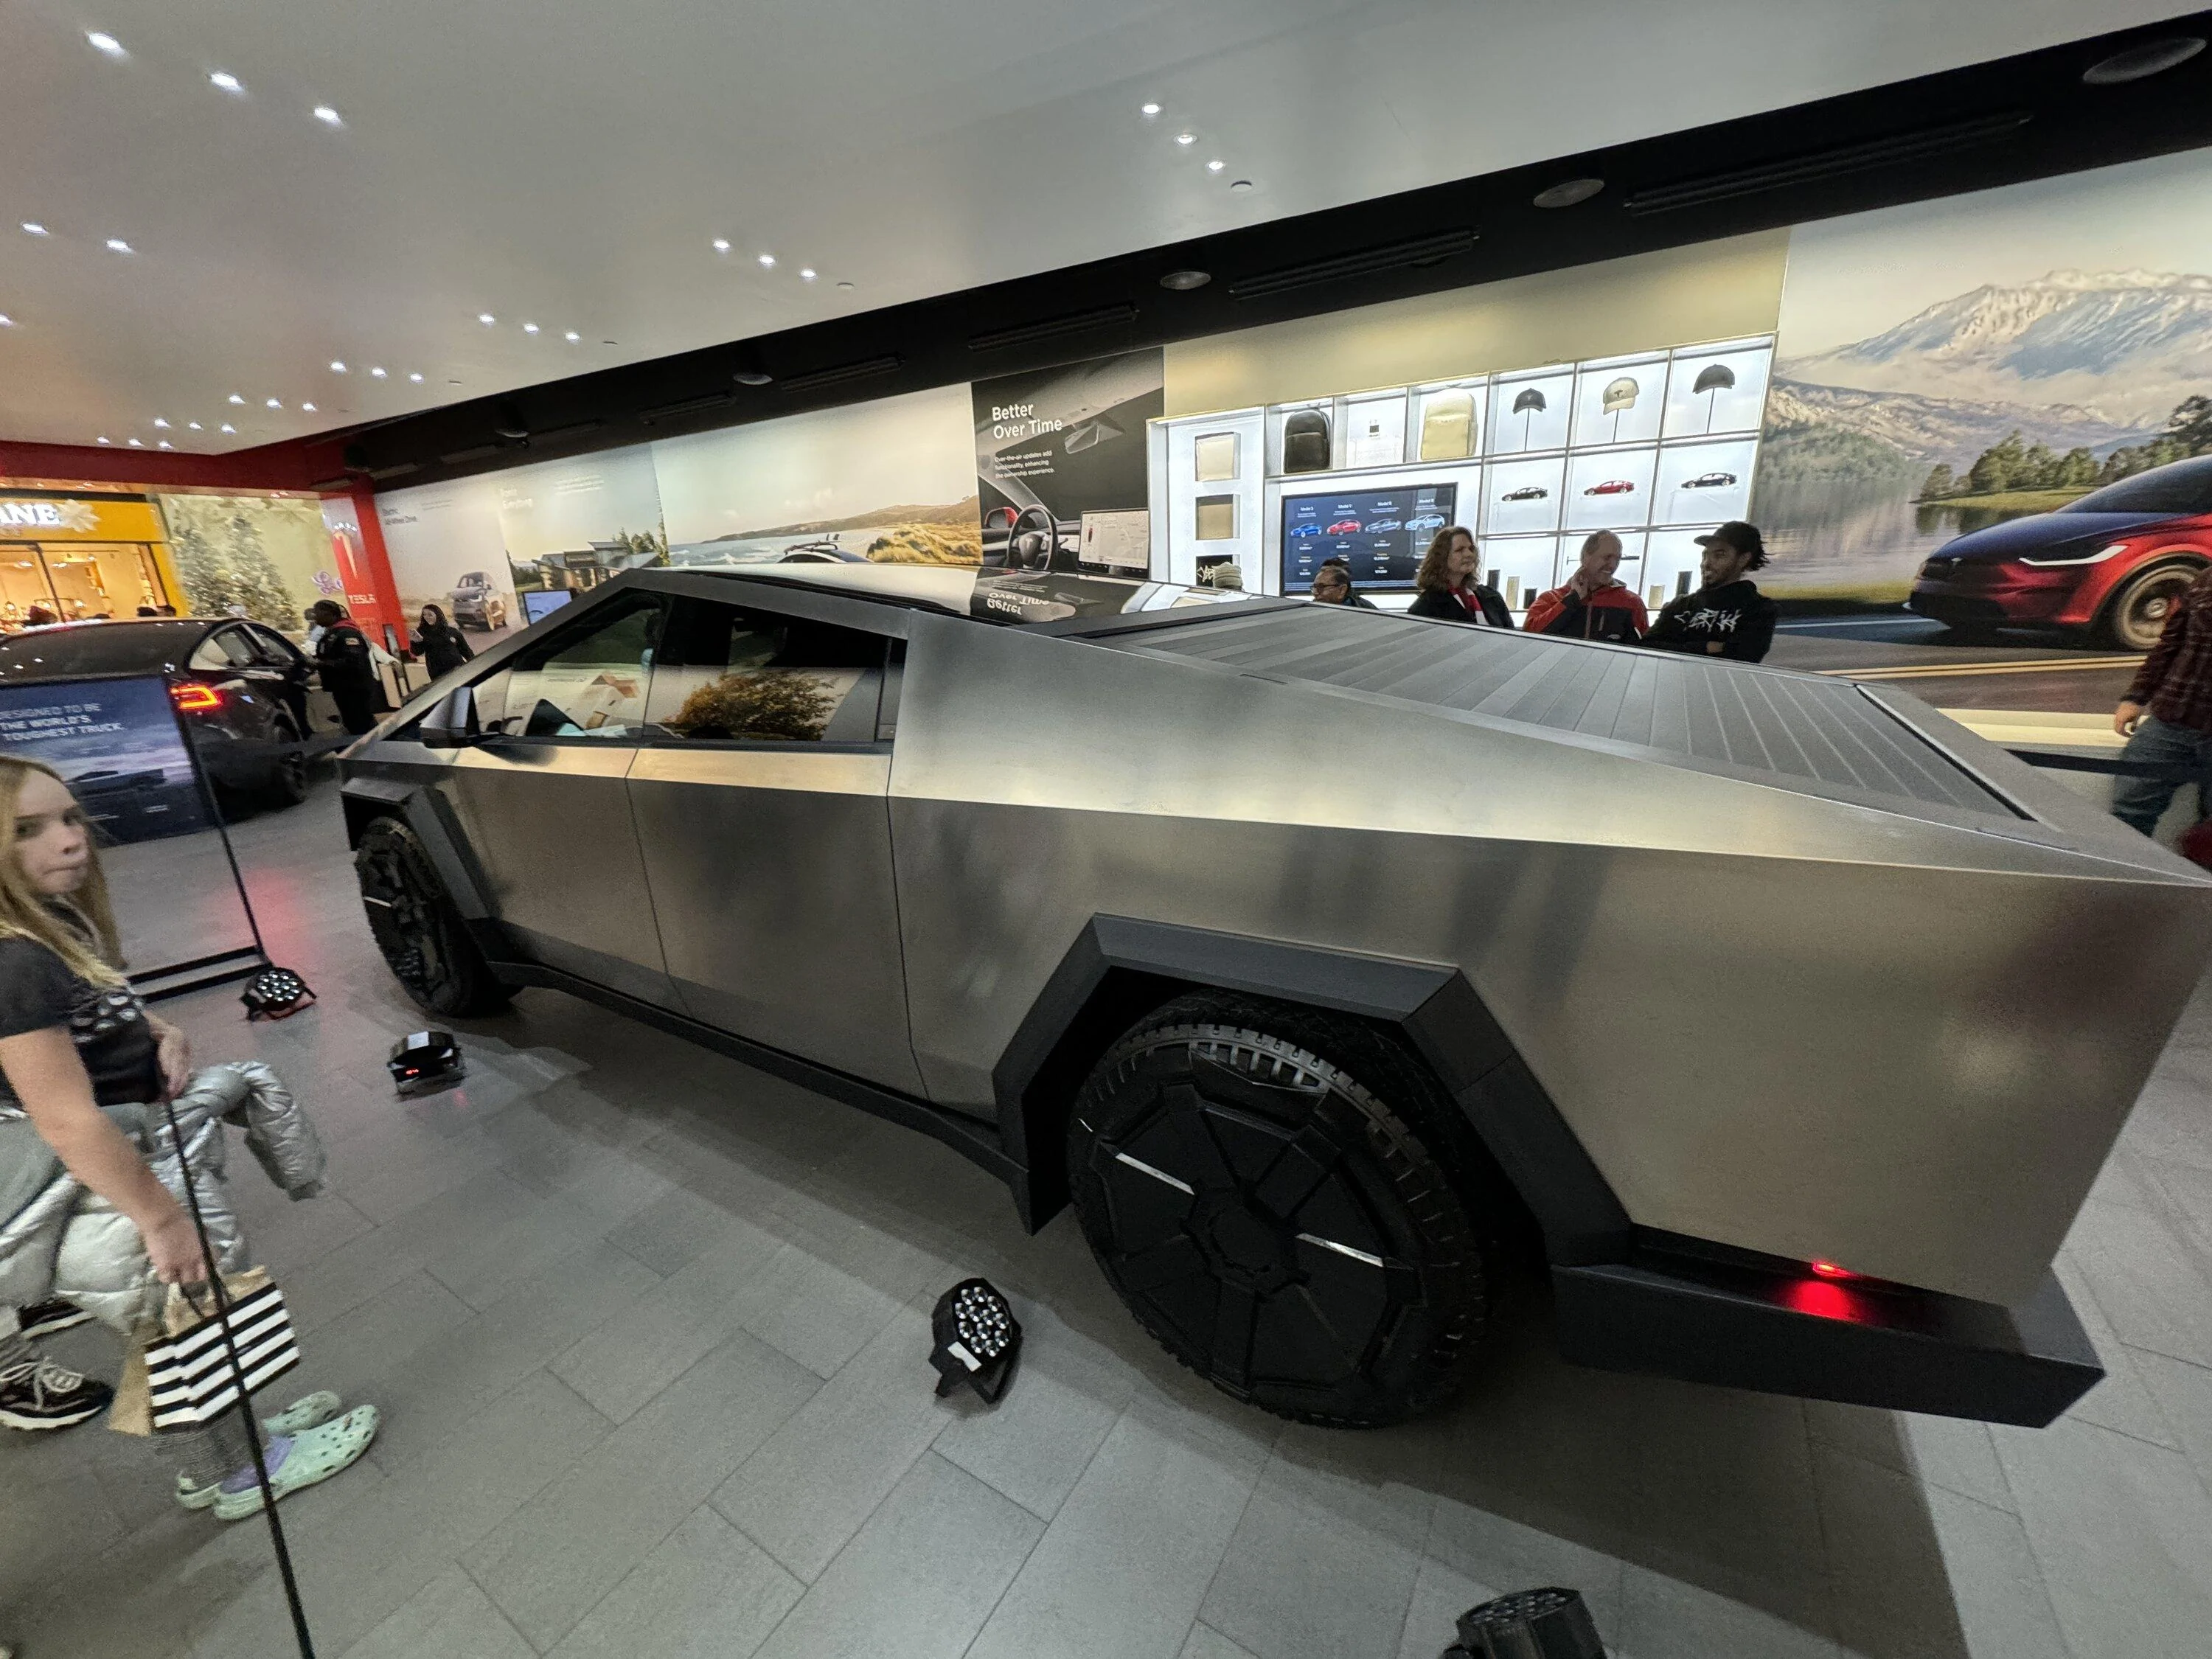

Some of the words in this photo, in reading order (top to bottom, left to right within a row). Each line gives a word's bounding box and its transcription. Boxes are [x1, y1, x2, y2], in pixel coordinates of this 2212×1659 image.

[992, 403, 1034, 421] Better
[993, 424, 1025, 439] Over
[1028, 418, 1062, 434] Time
[348, 594, 376, 604] TESLA
[63, 704, 83, 713] TO
[83, 703, 102, 712] BE
[1, 727, 75, 740] TOUGHEST
[77, 723, 127, 734] TRUCK
